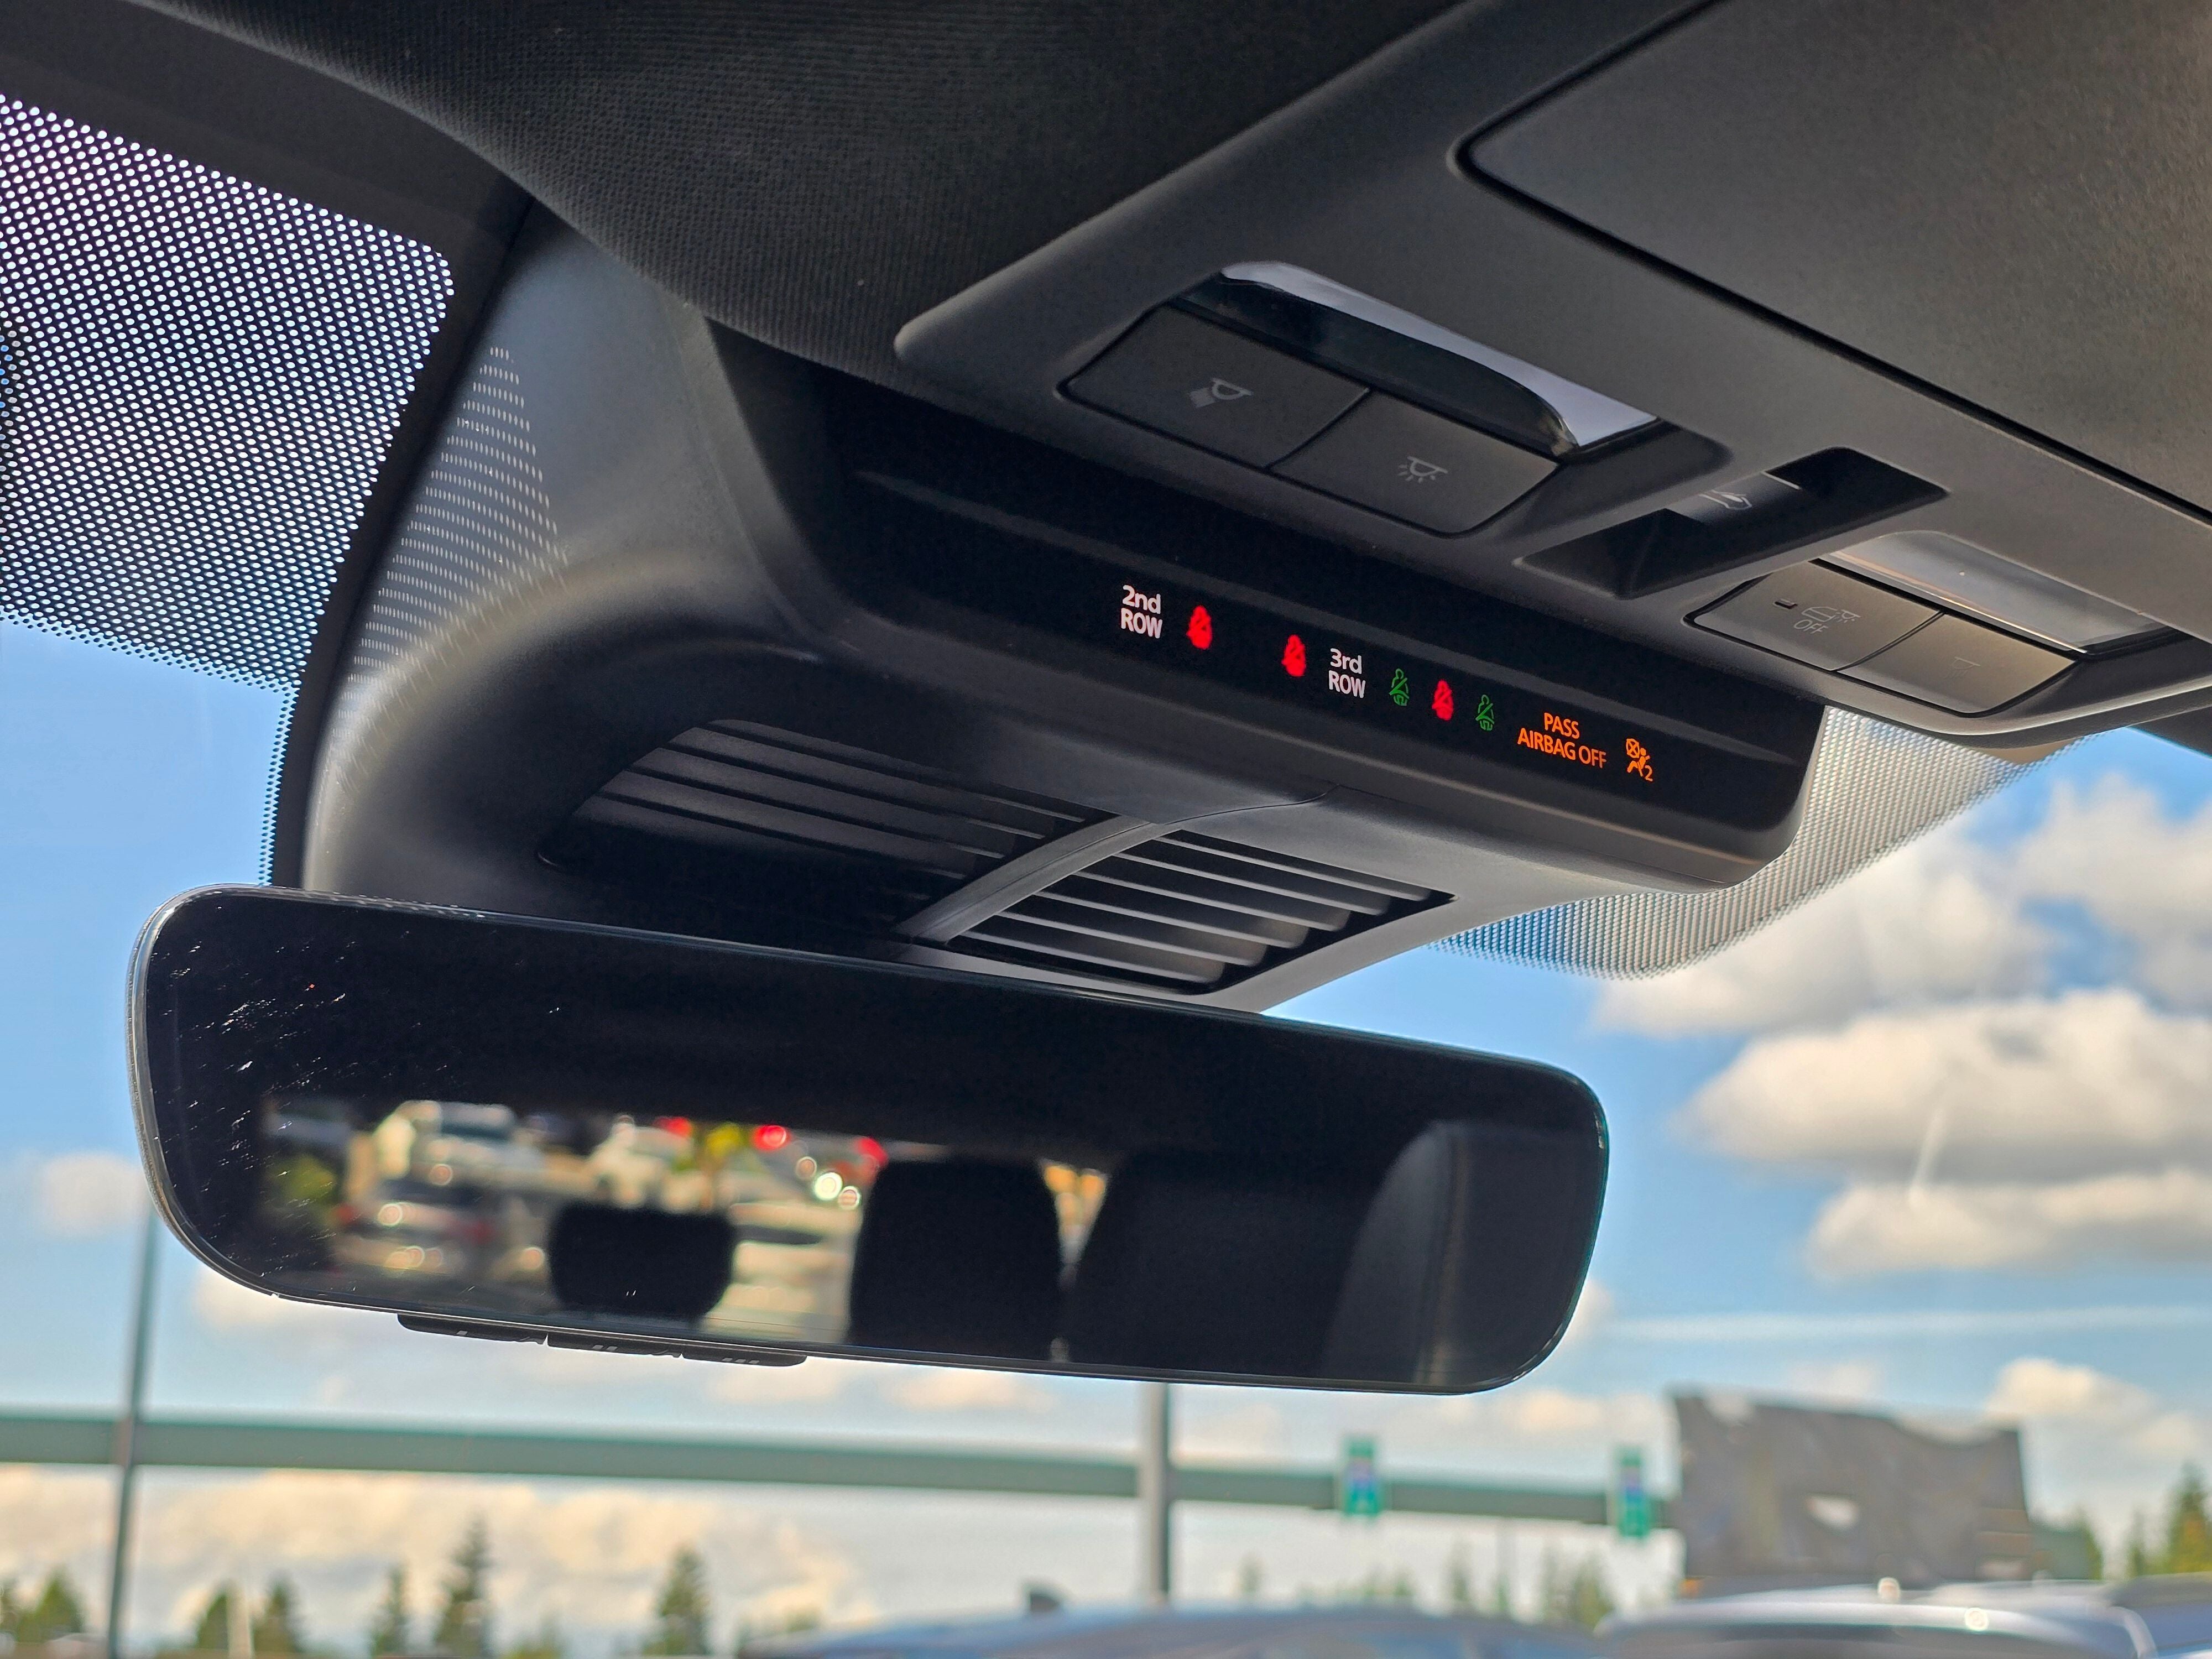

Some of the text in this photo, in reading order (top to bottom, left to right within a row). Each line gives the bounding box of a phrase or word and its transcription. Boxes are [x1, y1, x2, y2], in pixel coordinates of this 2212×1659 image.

[1122, 585, 1161, 615] 2nd
[1120, 608, 1162, 639] ROW
[1793, 619, 1829, 634] OFF
[1330, 648, 1363, 674] 3rd
[1328, 670, 1366, 698] ROW
[1543, 712, 1580, 739] PASS
[1517, 727, 1606, 769] AIRBAG OFF
[1645, 765, 1653, 781] 2
